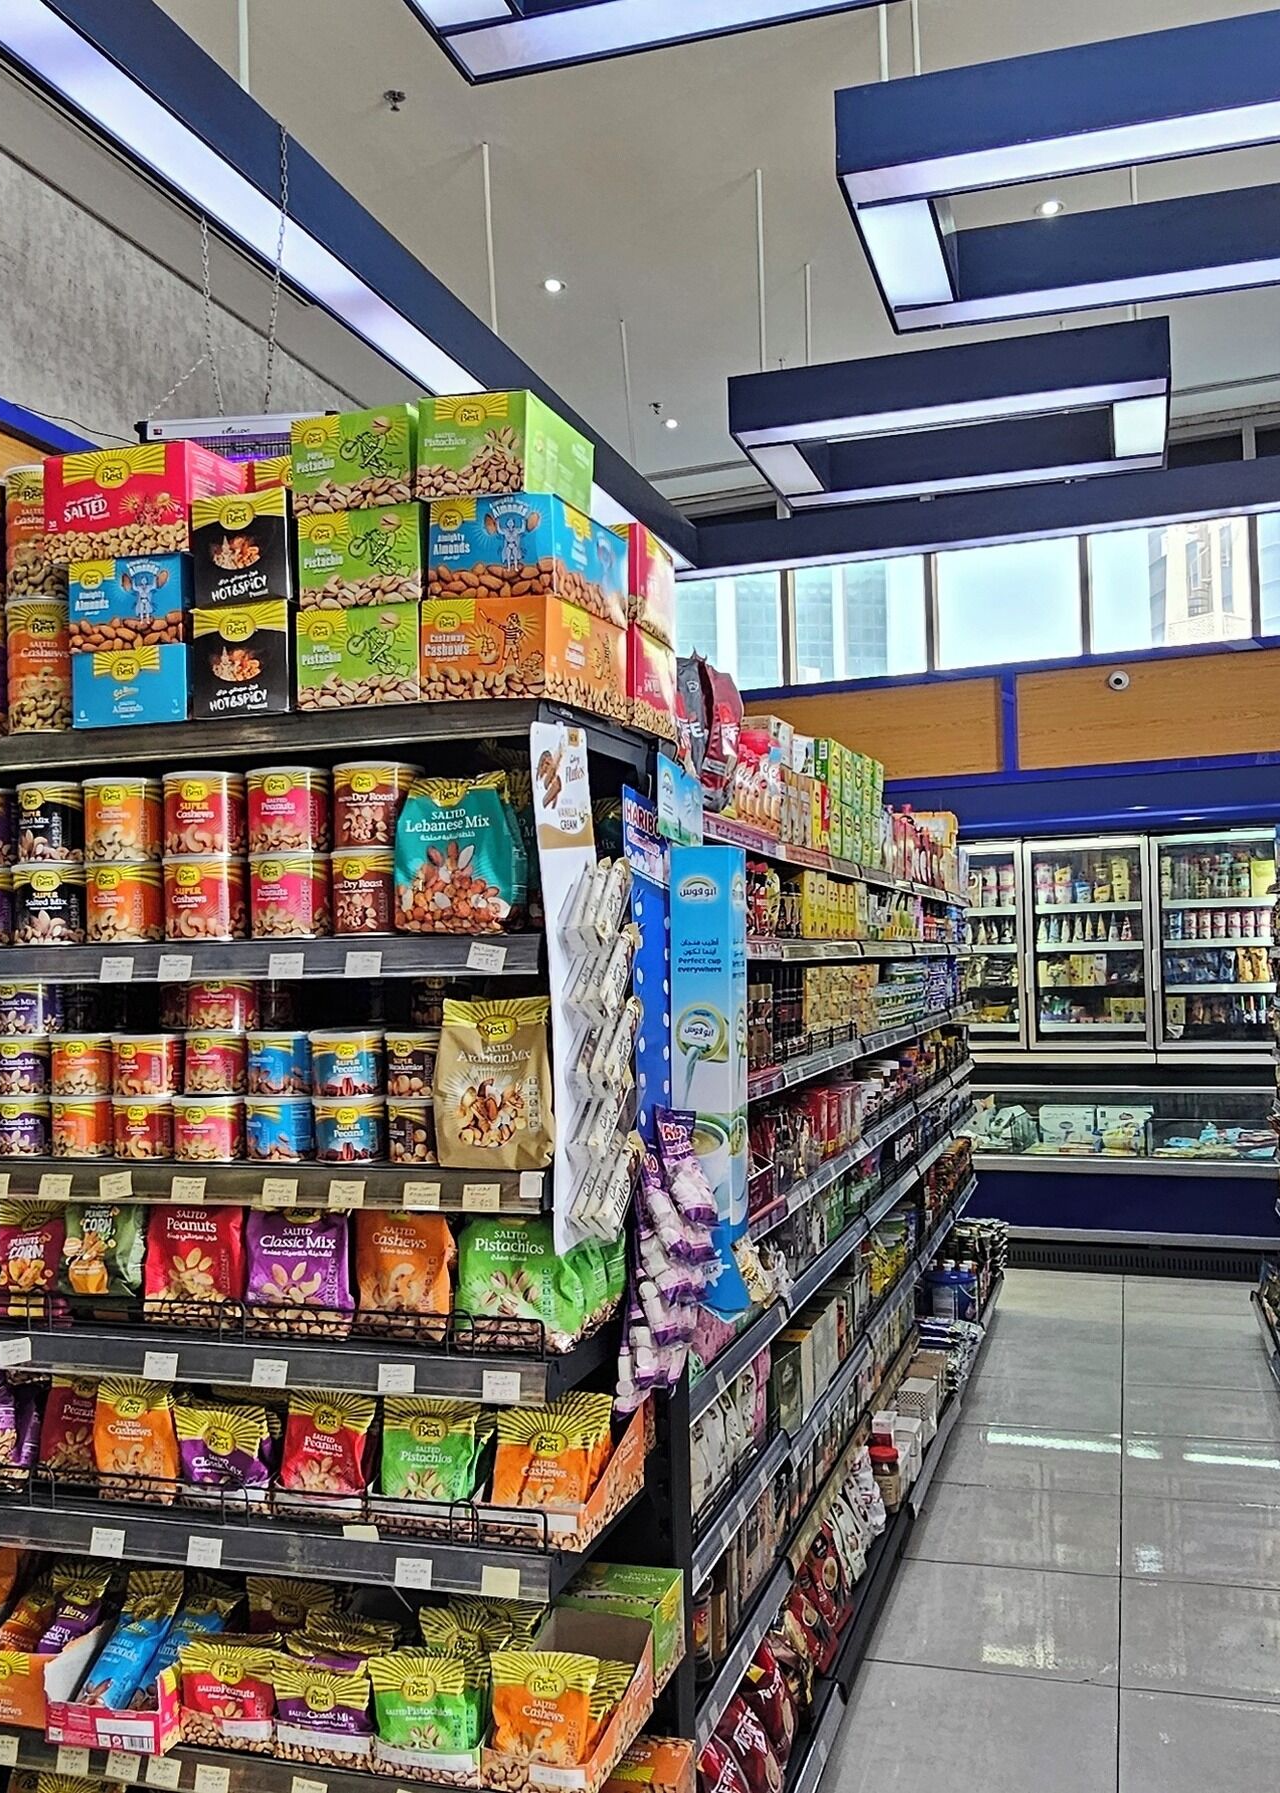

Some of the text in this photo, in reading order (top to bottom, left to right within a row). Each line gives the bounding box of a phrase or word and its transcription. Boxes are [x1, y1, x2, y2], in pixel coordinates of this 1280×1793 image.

[460, 413, 479, 422] Best
[102, 471, 123, 480] Best
[63, 499, 107, 522] SALTED
[225, 512, 247, 523] Best
[433, 544, 470, 555] Almonds
[226, 624, 248, 635] Best
[425, 643, 469, 656] Cashews
[369, 792, 394, 801] Roast
[432, 809, 465, 820] SALTED
[405, 816, 489, 832] Lebanese Mix
[677, 965, 721, 973] everywhere
[176, 1210, 207, 1219] SALTED
[167, 1218, 217, 1232] Peanuts
[283, 1228, 312, 1236] SALTED
[382, 1227, 416, 1236] SALTED
[494, 1231, 528, 1240] SALTED
[260, 1236, 336, 1248] Classic Mix
[372, 1232, 427, 1249] Cashews
[475, 1238, 545, 1255] Pistachios
[107, 1426, 152, 1438] Cashews
[417, 1424, 441, 1436] Best
[304, 1440, 344, 1453] Peanuts
[535, 1440, 559, 1453] Best
[400, 1453, 452, 1465] Pistachios
[406, 1685, 430, 1697] Best
[532, 1680, 558, 1693] Best
[522, 1707, 565, 1723] Cashews
